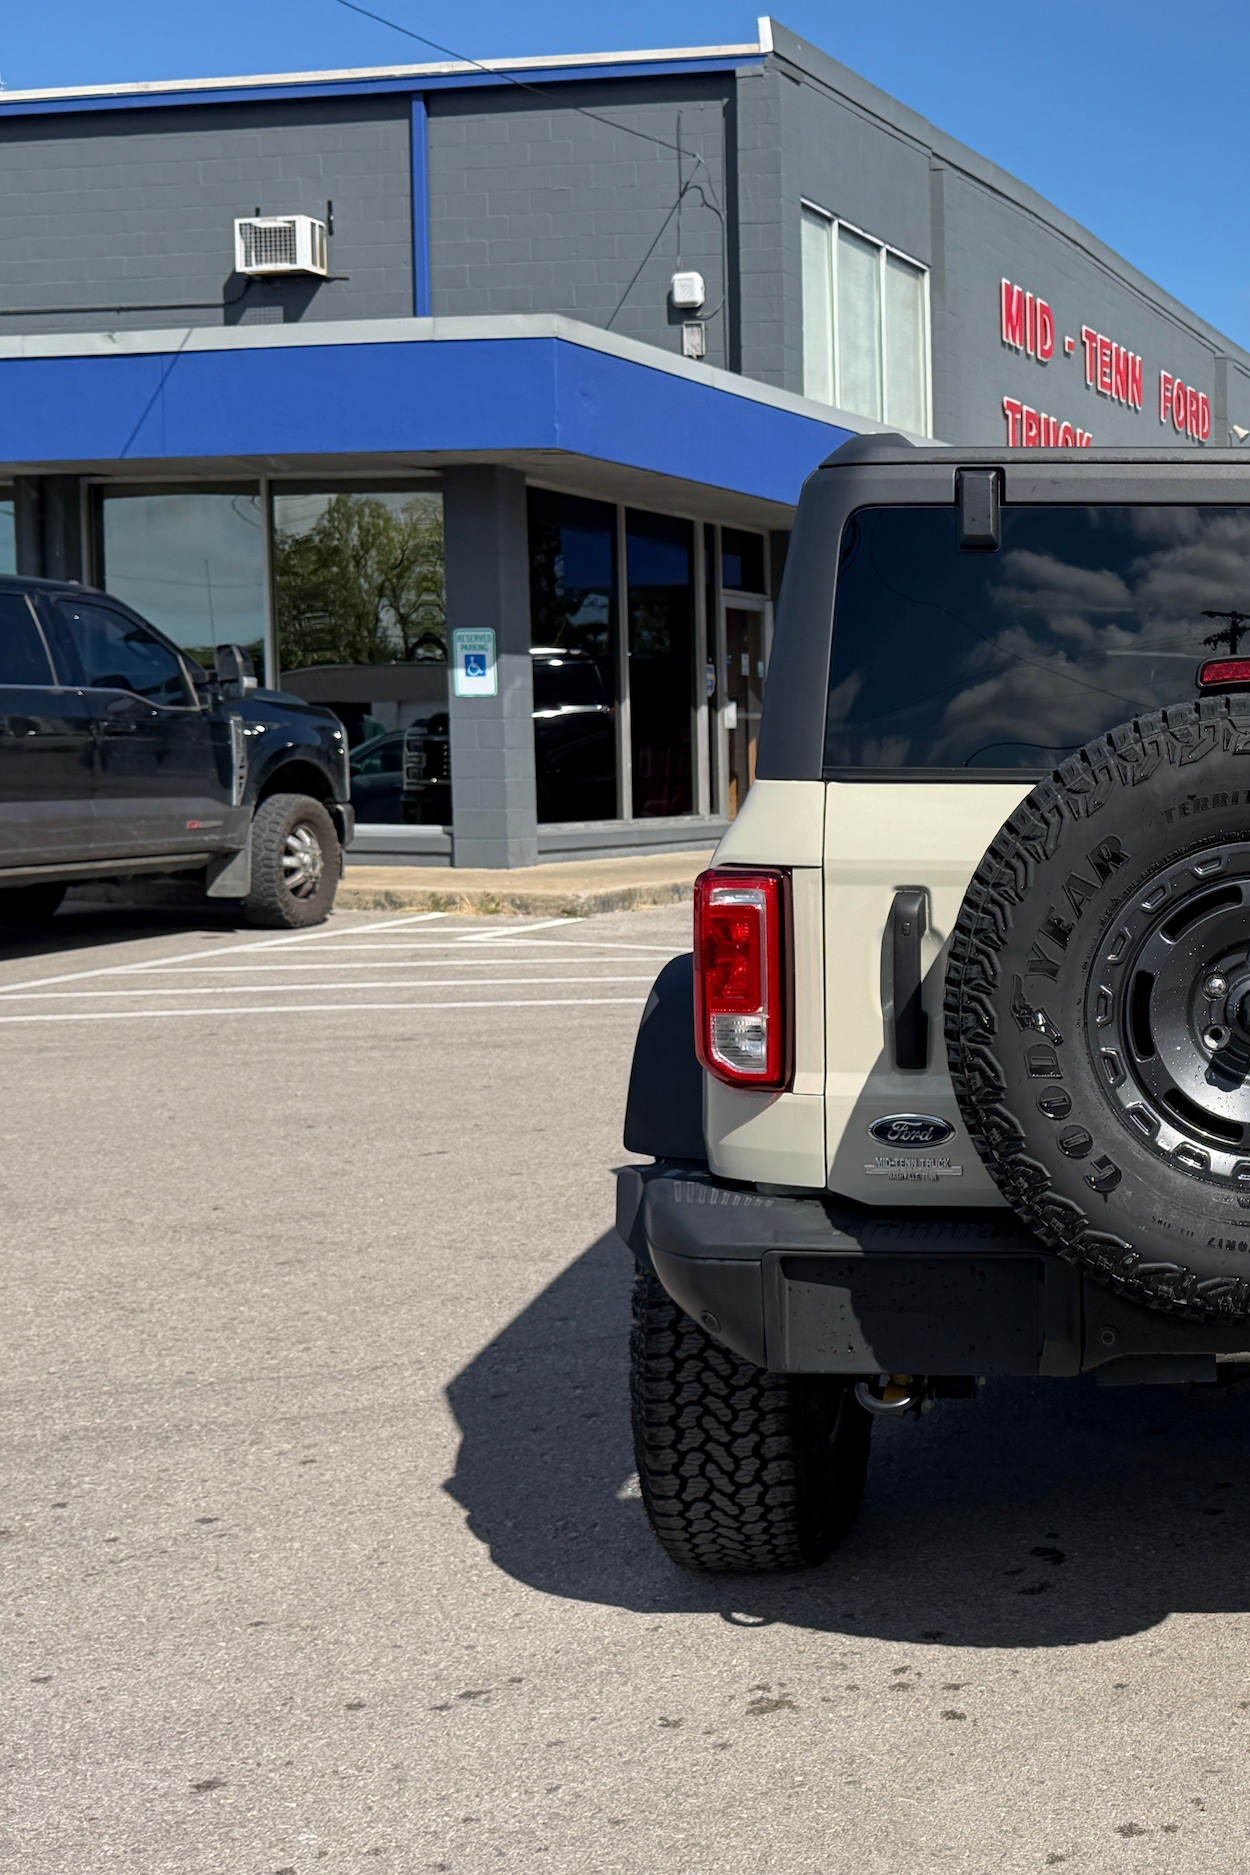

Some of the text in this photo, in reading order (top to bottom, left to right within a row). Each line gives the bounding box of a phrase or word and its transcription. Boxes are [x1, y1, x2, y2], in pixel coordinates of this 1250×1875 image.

[1001, 277, 1054, 362] MID
[1082, 325, 1143, 411] TENN
[1160, 370, 1211, 442] FORD
[457, 634, 492, 642] RESERVED
[461, 643, 489, 652] PARKING
[887, 1120, 934, 1141] Ford
[920, 1158, 950, 1168] TRUCK
